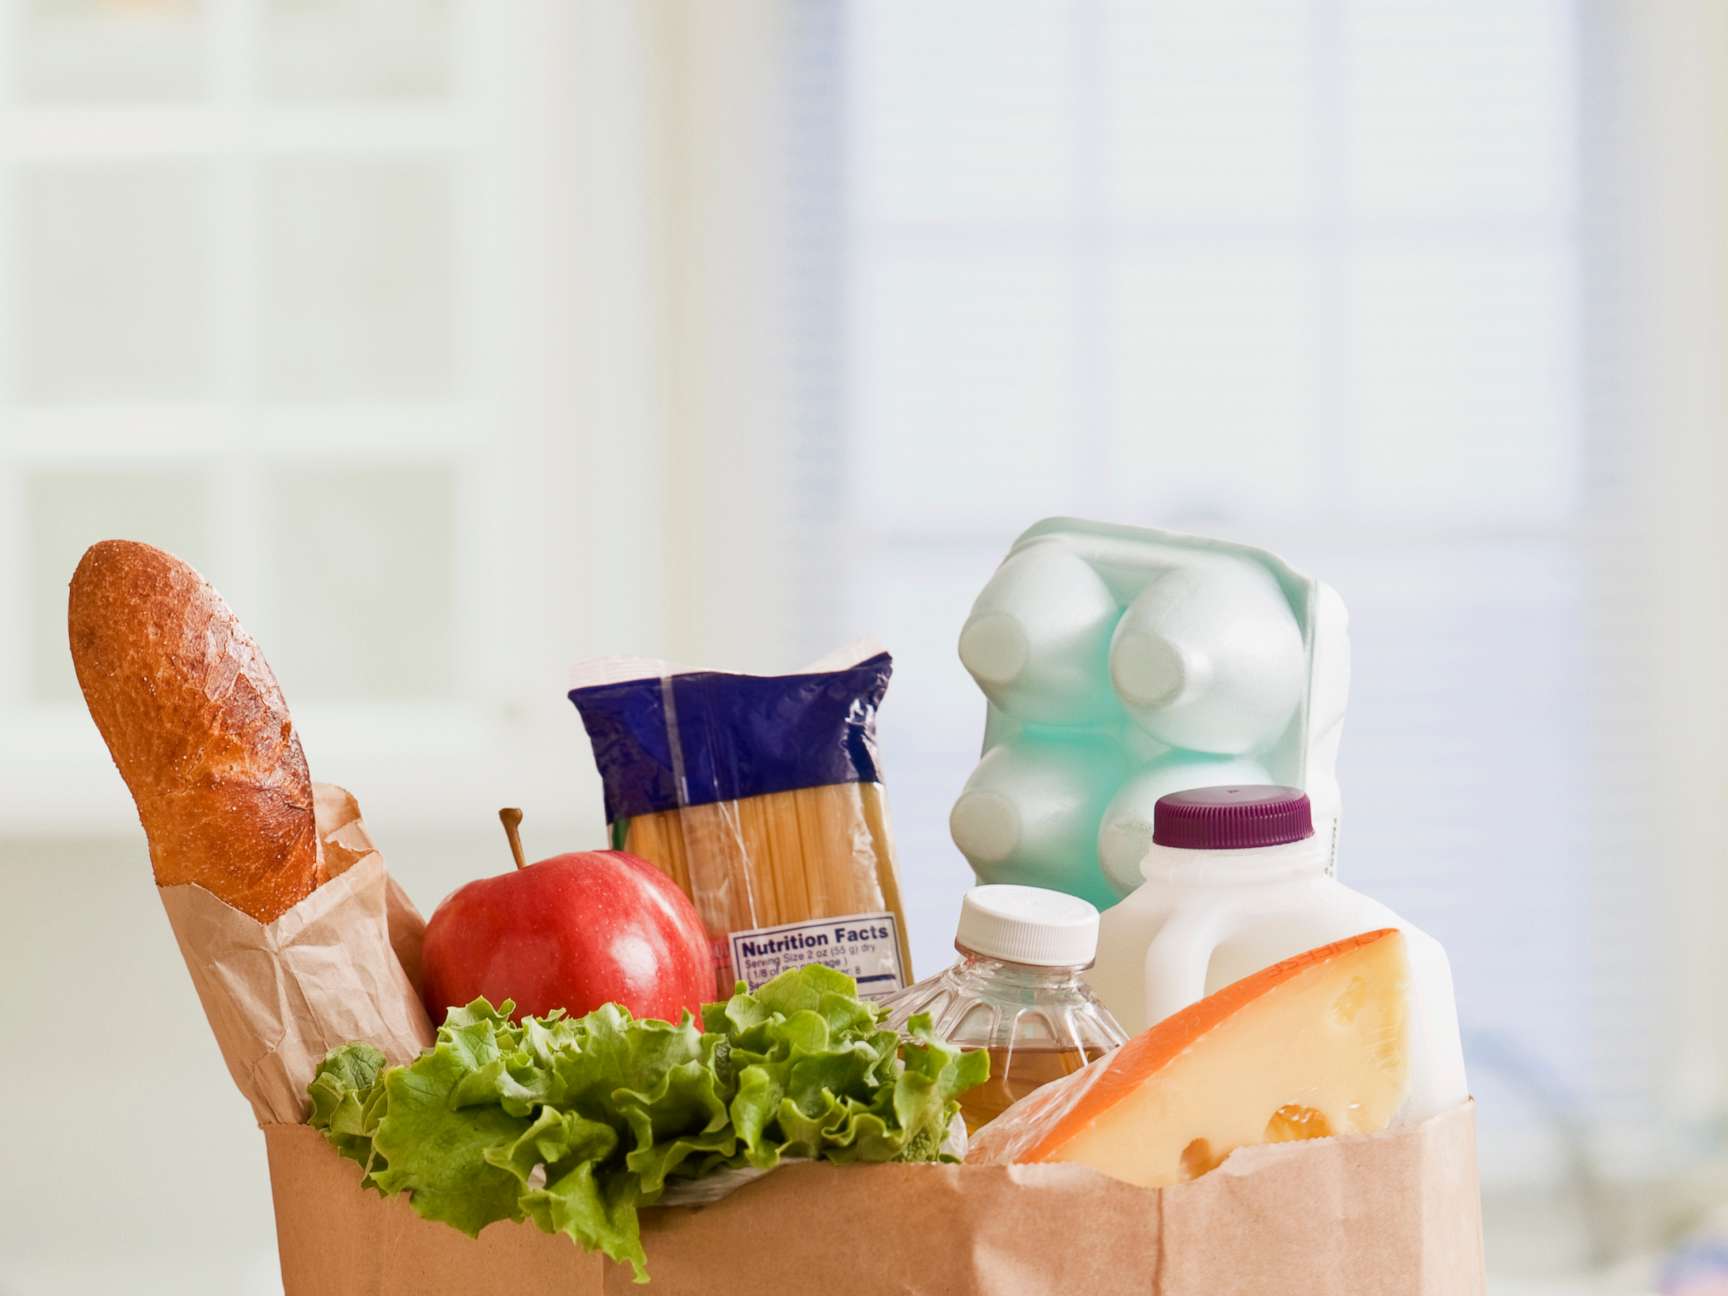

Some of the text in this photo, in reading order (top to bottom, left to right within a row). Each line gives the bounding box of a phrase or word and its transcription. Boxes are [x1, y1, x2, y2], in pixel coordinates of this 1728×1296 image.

[742, 925, 889, 957] Nutrition Facts
[745, 957, 780, 969] Serving
[783, 951, 805, 963] Size
[807, 949, 814, 960] 2
[815, 948, 830, 960] oz
